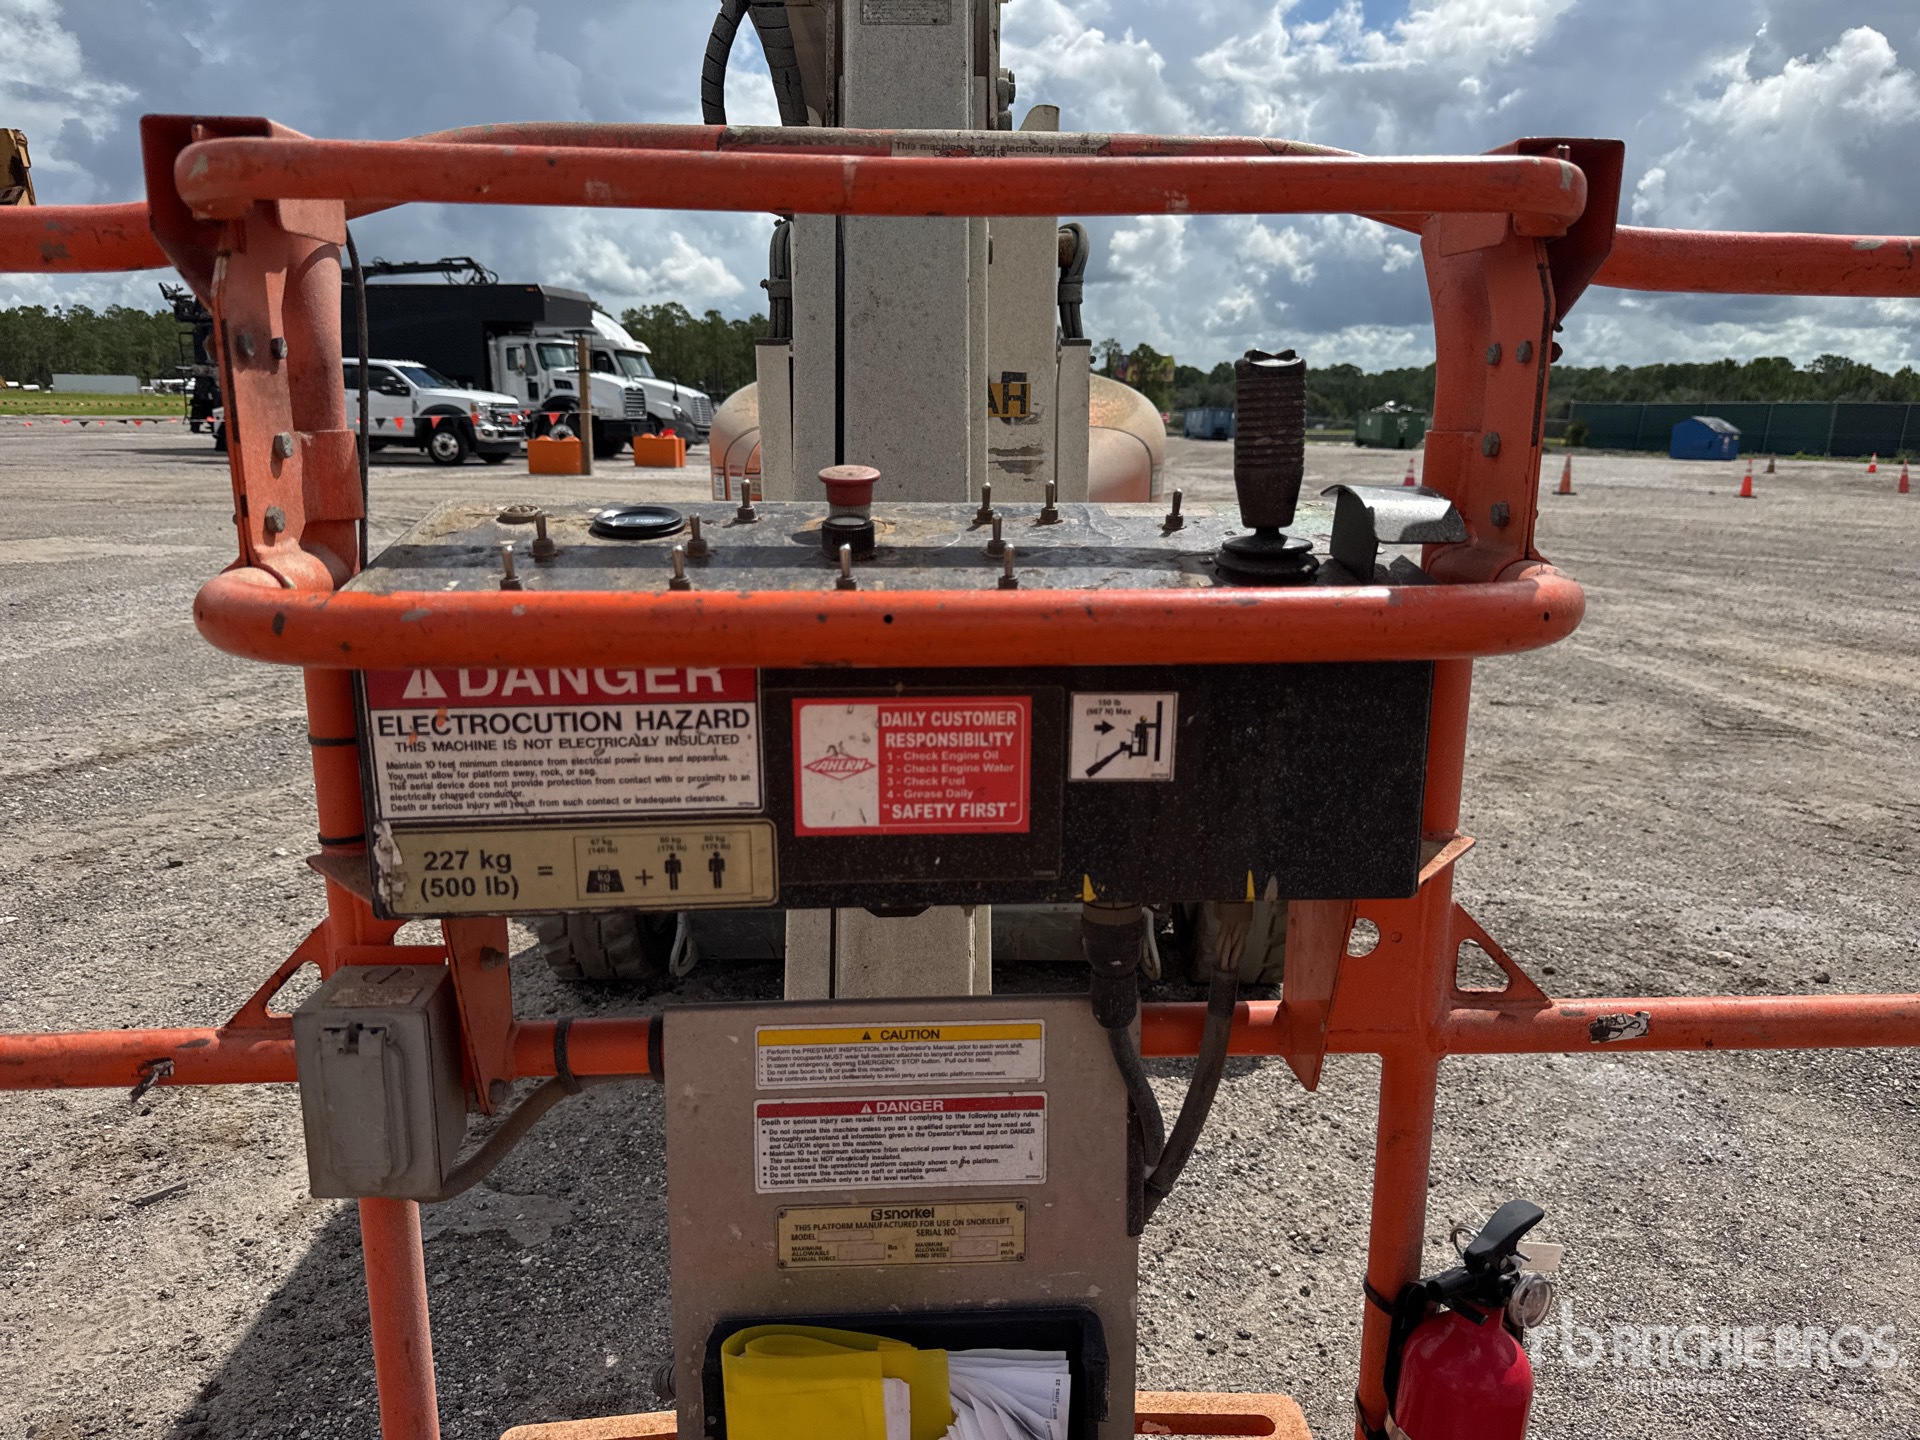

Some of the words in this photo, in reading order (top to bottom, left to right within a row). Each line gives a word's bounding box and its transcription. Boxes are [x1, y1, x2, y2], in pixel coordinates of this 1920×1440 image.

[896, 142, 916, 150] This
[980, 144, 996, 152] not
[1000, 144, 1054, 154] electrically
[458, 668, 724, 697] DANGER
[1116, 708, 1132, 716] Max
[378, 711, 621, 736] ELECTROCUTION
[636, 708, 749, 729] HAZARD
[882, 712, 926, 727] DAILY
[930, 711, 1017, 727] CUSTOMER
[396, 740, 426, 752] THIS
[432, 739, 496, 751] MACHINE
[503, 738, 516, 749] IS
[523, 737, 550, 749] NOT
[558, 735, 657, 748] ELECTRICALLY
[665, 733, 738, 746] INSULATED
[885, 732, 1014, 748] RESPONSIBILITY
[386, 761, 421, 769] Maintain
[425, 760, 435, 768] 10
[438, 760, 455, 768] feet
[459, 759, 497, 767] minimum
[501, 758, 543, 766] clearance
[547, 757, 567, 765] from
[571, 756, 611, 764] electrical
[614, 757, 640, 765] power
[644, 754, 663, 762] lines
[668, 754, 683, 762] and
[686, 753, 729, 763] apparatus.
[888, 752, 893, 760] 1
[903, 751, 938, 760] Check
[942, 751, 980, 762] Engine
[983, 751, 999, 760] Oil
[388, 771, 403, 779] You
[406, 771, 427, 779] must
[431, 770, 453, 778] allow
[472, 769, 509, 779] platform
[512, 770, 537, 778] sway,
[540, 767, 562, 777] rock,
[579, 768, 597, 776] sag.
[888, 765, 893, 773] 2
[903, 764, 938, 773] Check
[942, 764, 980, 774] Engine
[982, 764, 1014, 773] Water
[389, 782, 406, 790] This
[410, 781, 433, 789] aerial
[436, 780, 464, 789] device
[468, 780, 489, 788] does
[493, 779, 507, 787] not
[511, 778, 543, 788] provide
[547, 777, 591, 787] protection
[595, 776, 615, 784] from
[618, 775, 651, 783] contact
[655, 774, 672, 782] with
[687, 773, 725, 784] proximity
[888, 777, 893, 786] 3
[903, 777, 938, 786] Check
[942, 776, 965, 786] Fuel
[390, 792, 435, 803] electrically
[440, 791, 474, 801] charged
[888, 790, 893, 799] 4
[904, 790, 942, 799] Grease
[945, 789, 973, 800] Daily
[390, 803, 415, 811] Death
[431, 801, 462, 810] serious
[466, 801, 489, 811] injury
[494, 800, 507, 808] will
[510, 799, 535, 807] result
[539, 799, 559, 807] from
[562, 798, 583, 806] such
[586, 797, 619, 805] contact
[635, 795, 681, 806] inadequate
[685, 794, 727, 802] clearance.
[424, 852, 469, 871] 227
[480, 850, 512, 874] kg
[420, 878, 476, 902] (500
[486, 876, 519, 899] lb)
[880, 1029, 940, 1041] CAUTION
[876, 1100, 944, 1113] DANGER
[820, 1117, 838, 1126] injury
[908, 1114, 942, 1123] complying
[968, 1112, 997, 1121] following
[1000, 1112, 1020, 1120] safety
[855, 1221, 917, 1229] MANUFACTURED
